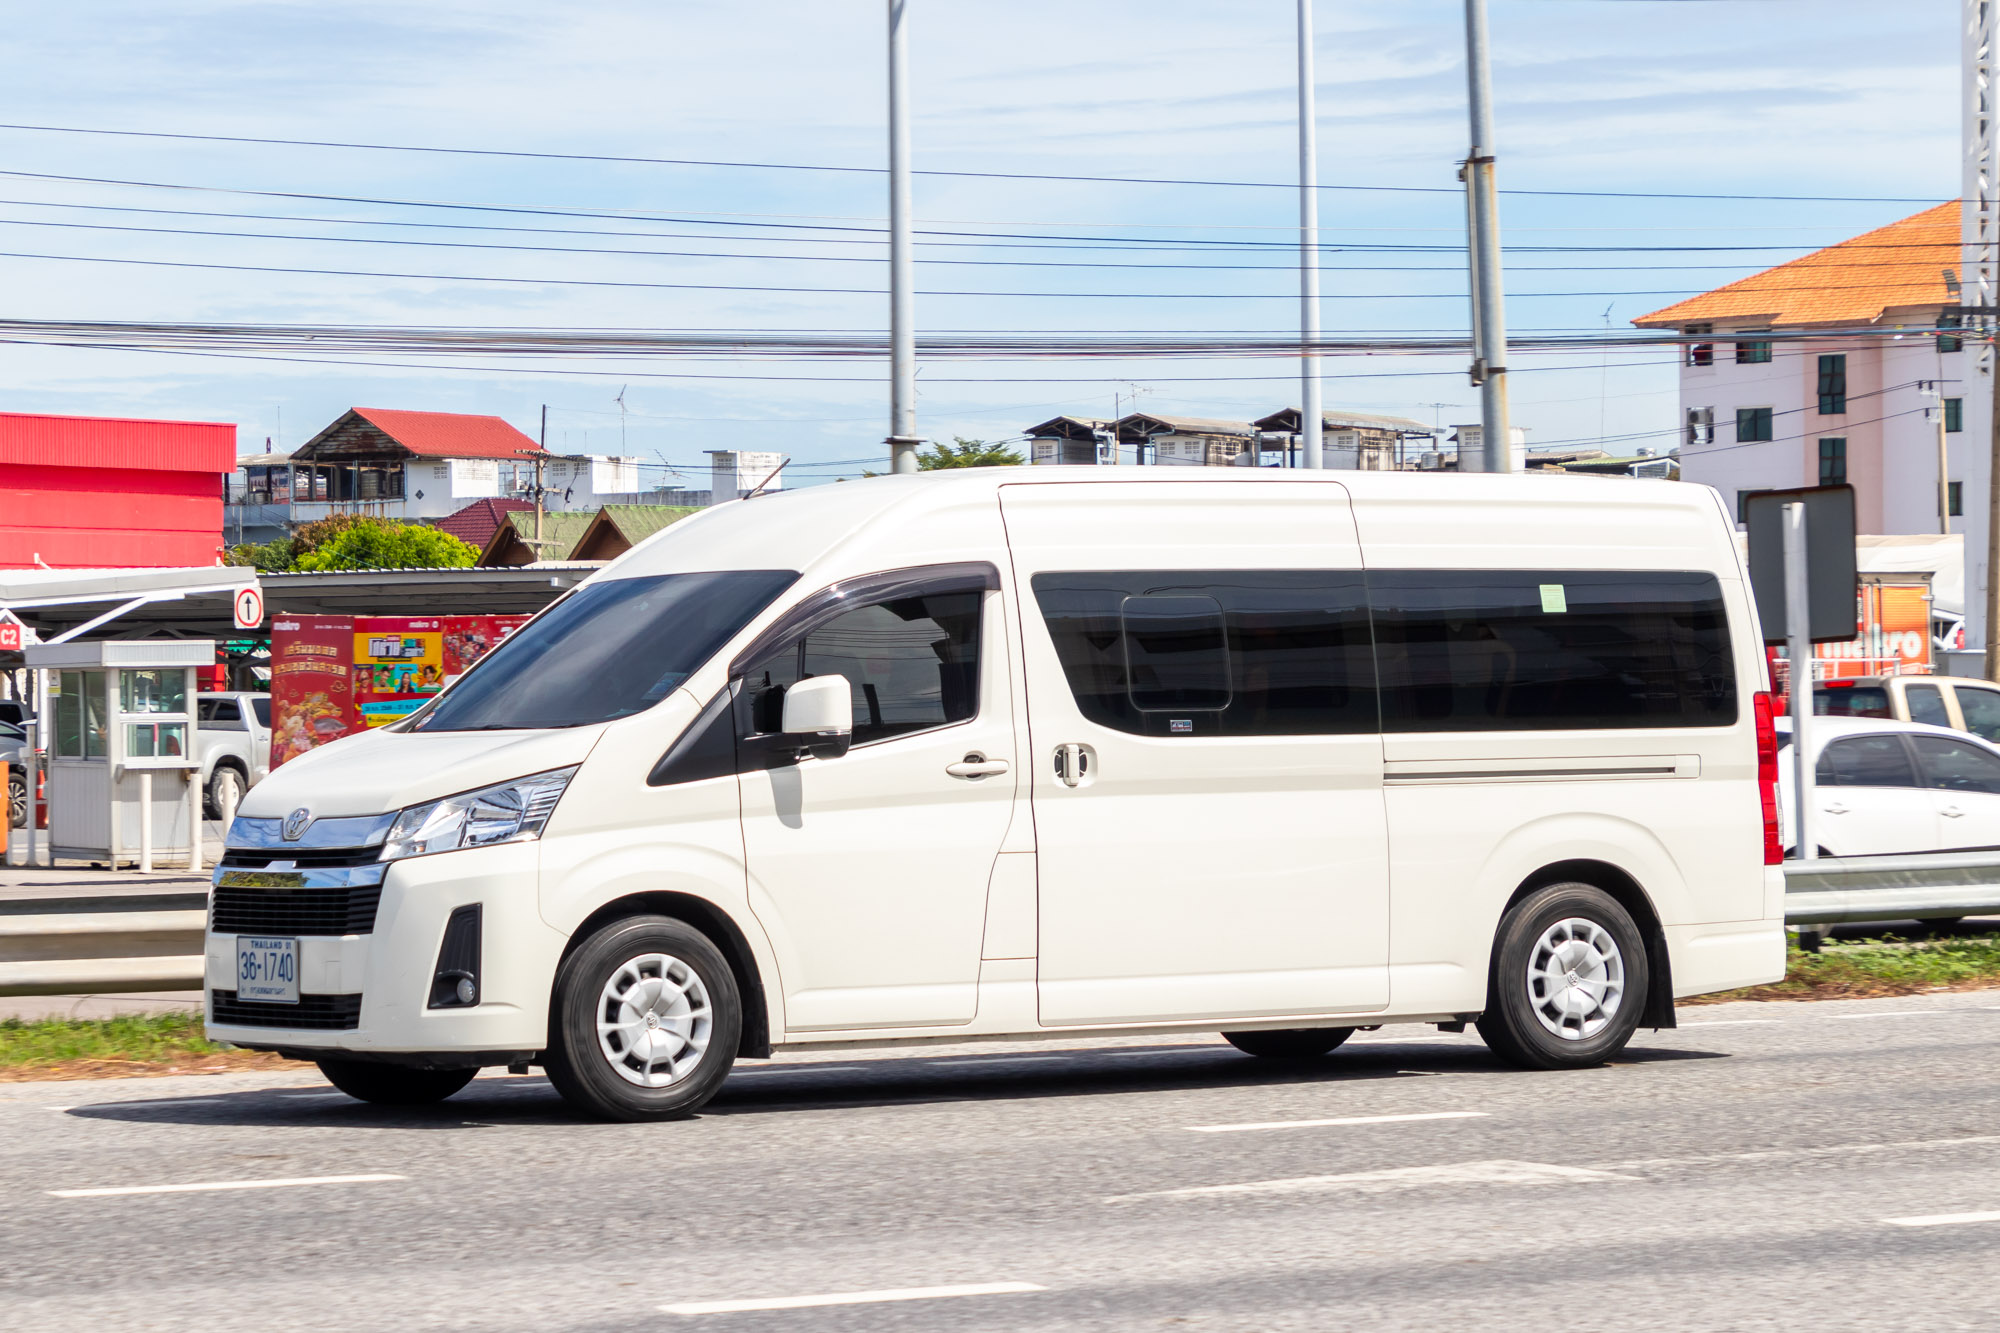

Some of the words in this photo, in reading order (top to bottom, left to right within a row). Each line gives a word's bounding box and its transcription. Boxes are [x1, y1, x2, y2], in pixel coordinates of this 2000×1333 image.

[0, 629, 17, 645] C2
[250, 940, 283, 949] THAILAND
[240, 951, 294, 982] 36-1740
